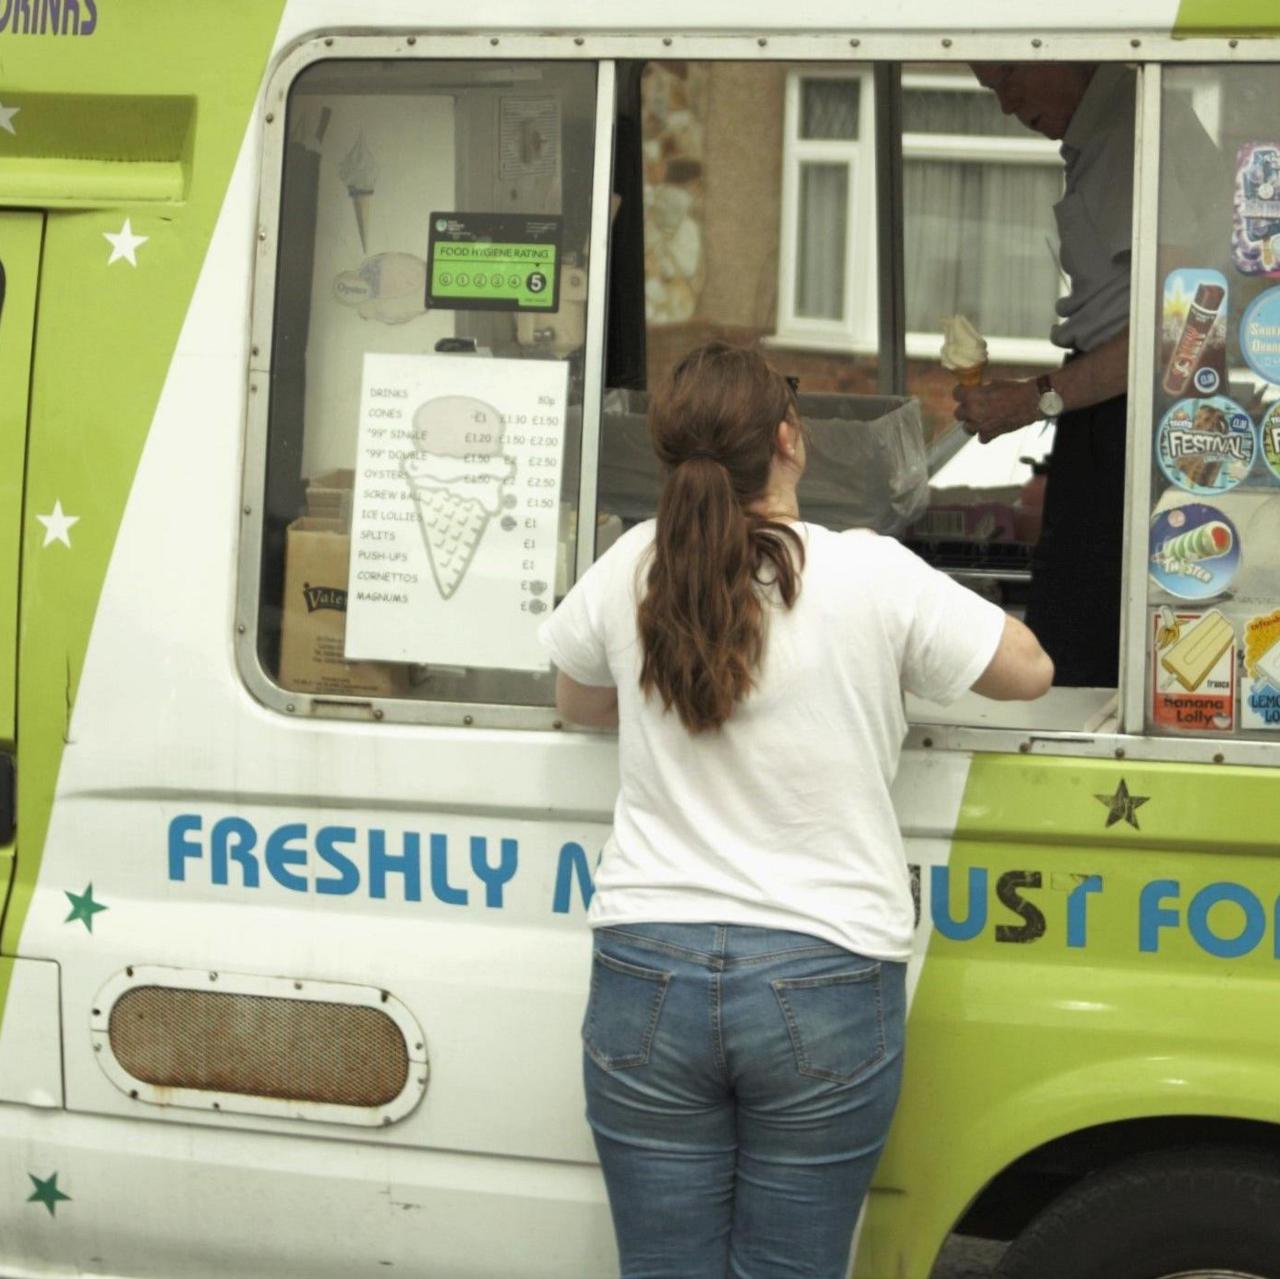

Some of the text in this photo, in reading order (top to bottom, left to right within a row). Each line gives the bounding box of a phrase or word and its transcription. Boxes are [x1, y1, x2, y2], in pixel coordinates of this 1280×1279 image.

[440, 246, 549, 259] FOOD HYGIENE RATING
[530, 274, 542, 291] 5
[369, 388, 408, 399] DRINKS
[368, 408, 402, 419] CONES
[390, 429, 428, 441] SINGLE
[1168, 431, 1248, 460] FESTIVAL
[388, 450, 428, 461] DOUBLE
[363, 469, 410, 480] OYSTERS
[362, 489, 397, 499] SCREW
[361, 509, 424, 522] ICE LOLLIES
[524, 518, 537, 529] £1
[359, 530, 396, 541] SPLITS
[523, 539, 536, 549] £1
[357, 550, 408, 562] PUSH-UPS
[356, 570, 419, 584] CORNETTOS
[308, 589, 348, 609] Vale
[356, 591, 409, 604] MAGNUMS
[1176, 709, 1213, 724] Lolly
[167, 813, 519, 909] FRESHLY
[907, 864, 1103, 948] UST
